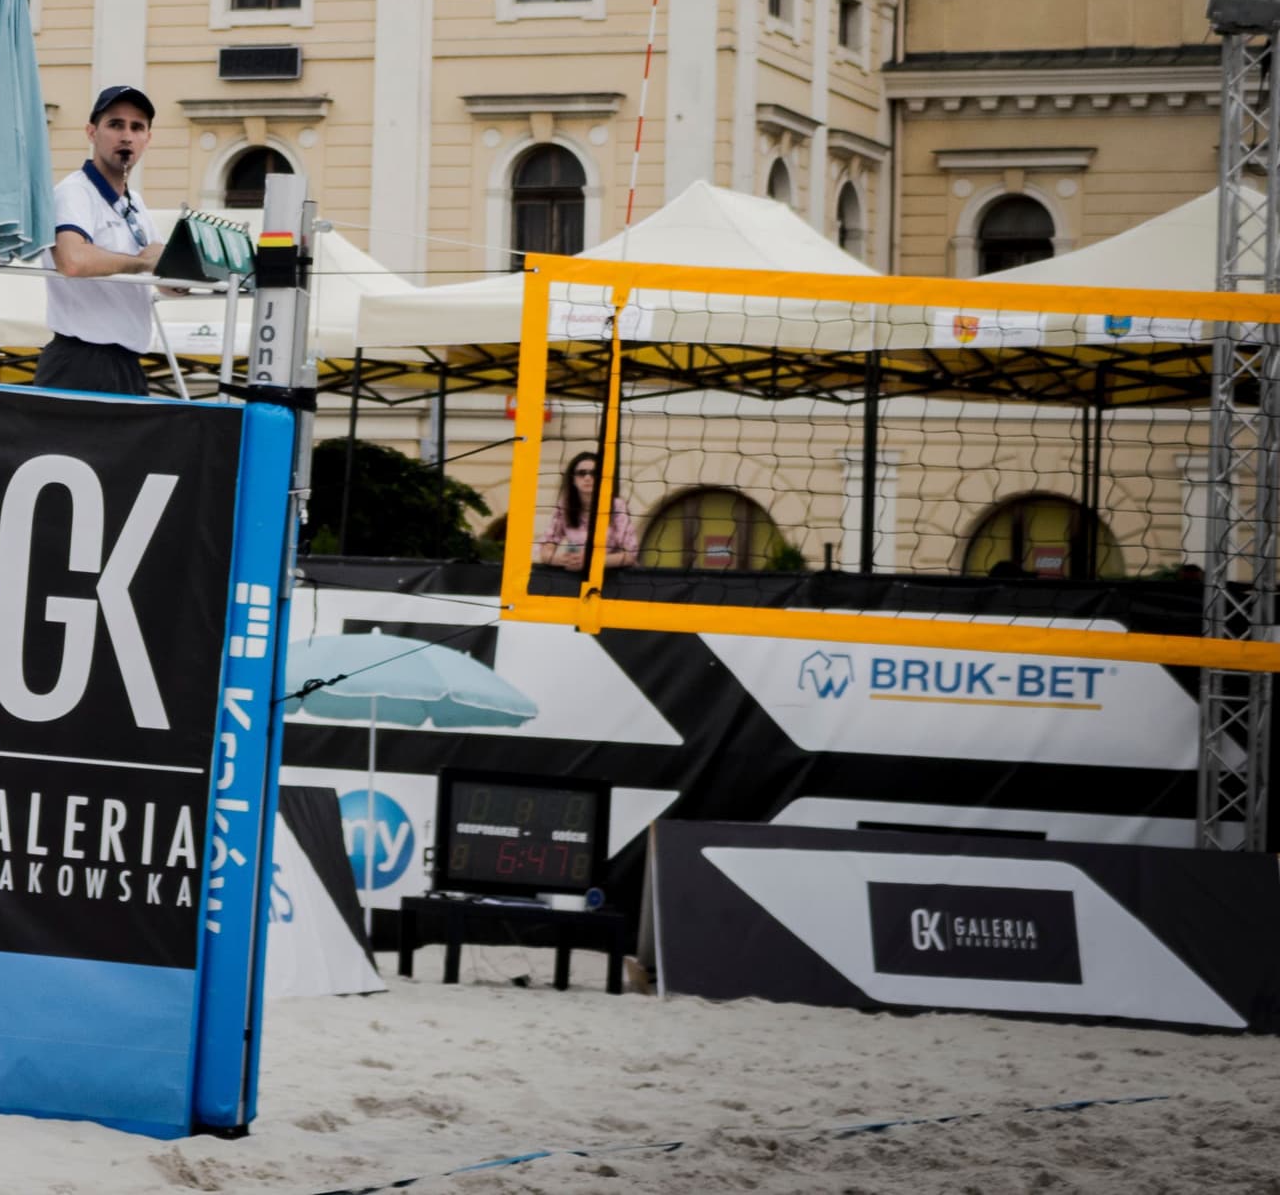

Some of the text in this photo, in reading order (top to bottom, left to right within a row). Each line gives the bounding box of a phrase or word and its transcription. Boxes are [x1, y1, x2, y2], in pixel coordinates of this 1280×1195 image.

[870, 657, 1105, 699] BRUK-BET
[910, 908, 945, 951] GK
[953, 916, 1037, 940] GALERIA
